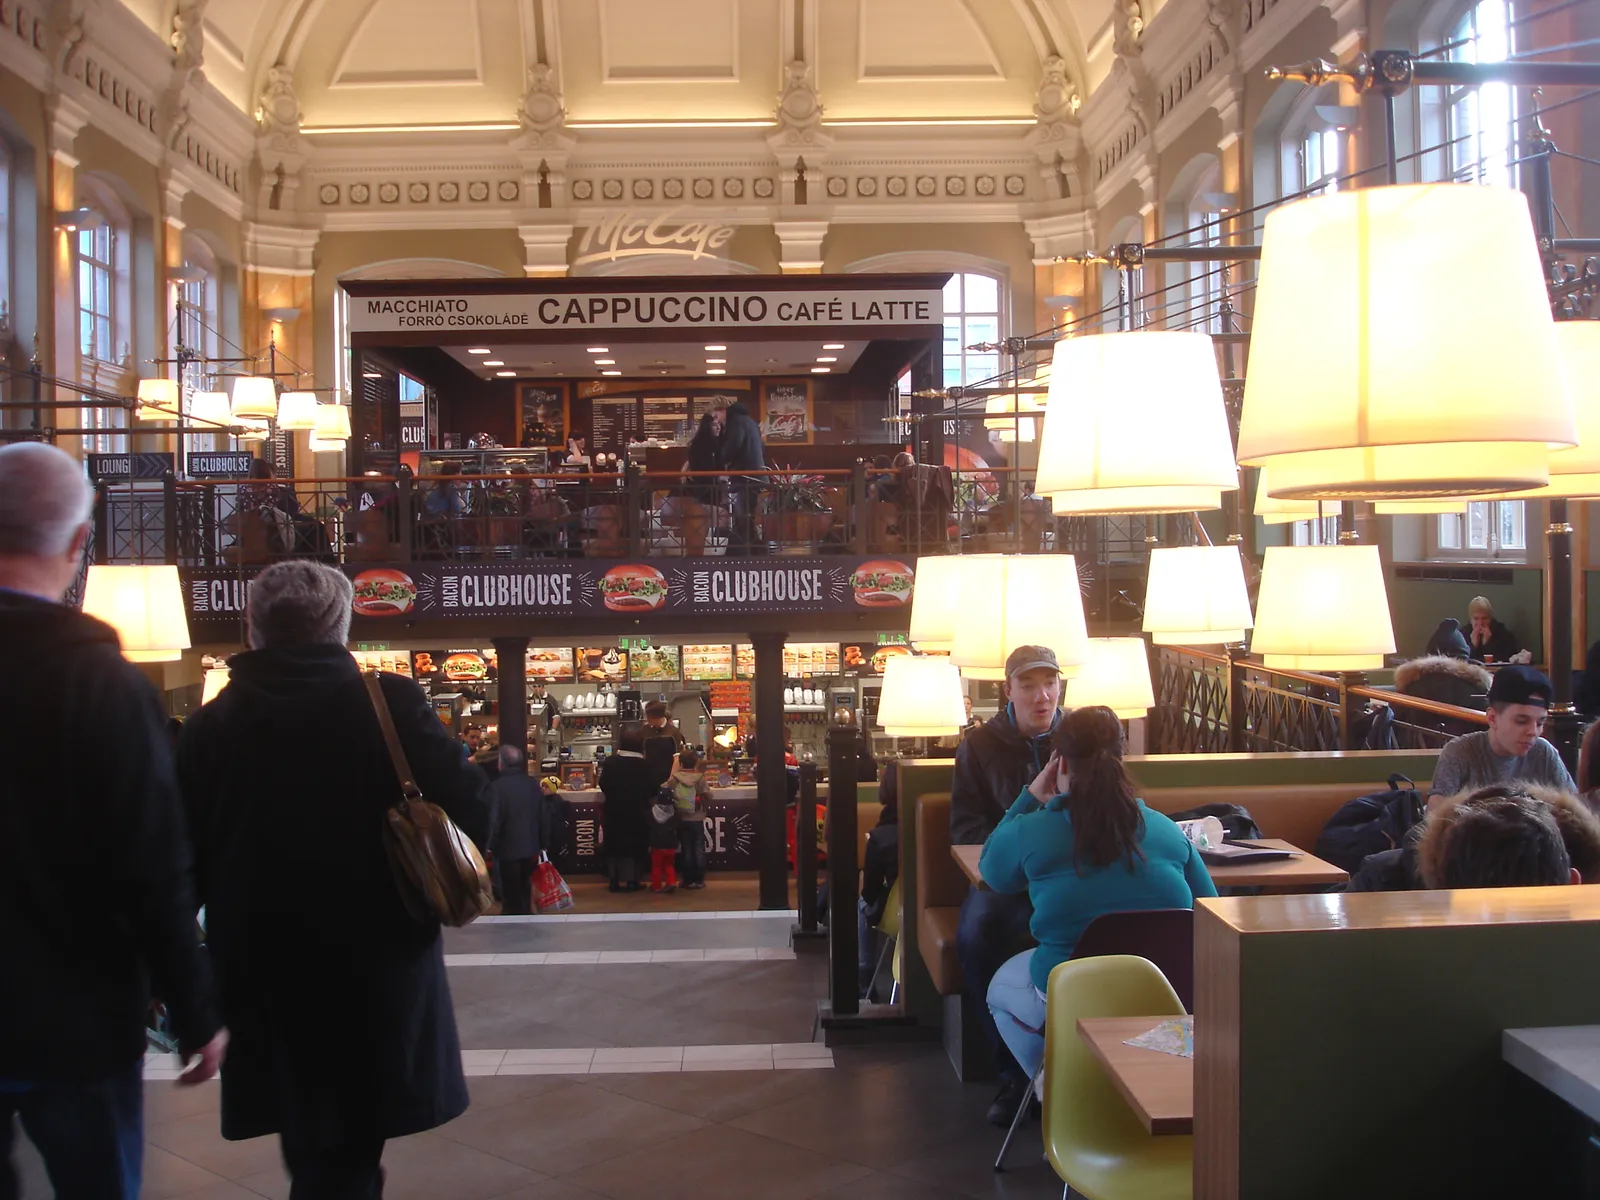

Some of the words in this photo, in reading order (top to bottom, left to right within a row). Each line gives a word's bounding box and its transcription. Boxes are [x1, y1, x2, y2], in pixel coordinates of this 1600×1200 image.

[368, 299, 468, 314] MACCHIATO
[538, 295, 768, 325] CAPPUCCINO
[777, 297, 843, 321] CAFÉ
[851, 301, 930, 320] LATTE
[398, 313, 444, 327] FORRÓ
[192, 580, 208, 611] BACON
[442, 576, 459, 607] BACON
[461, 573, 572, 607] CLUBHOUSE
[693, 571, 710, 603] BACON
[712, 569, 823, 603] CLUBHOUSE
[576, 819, 595, 856] BACON
